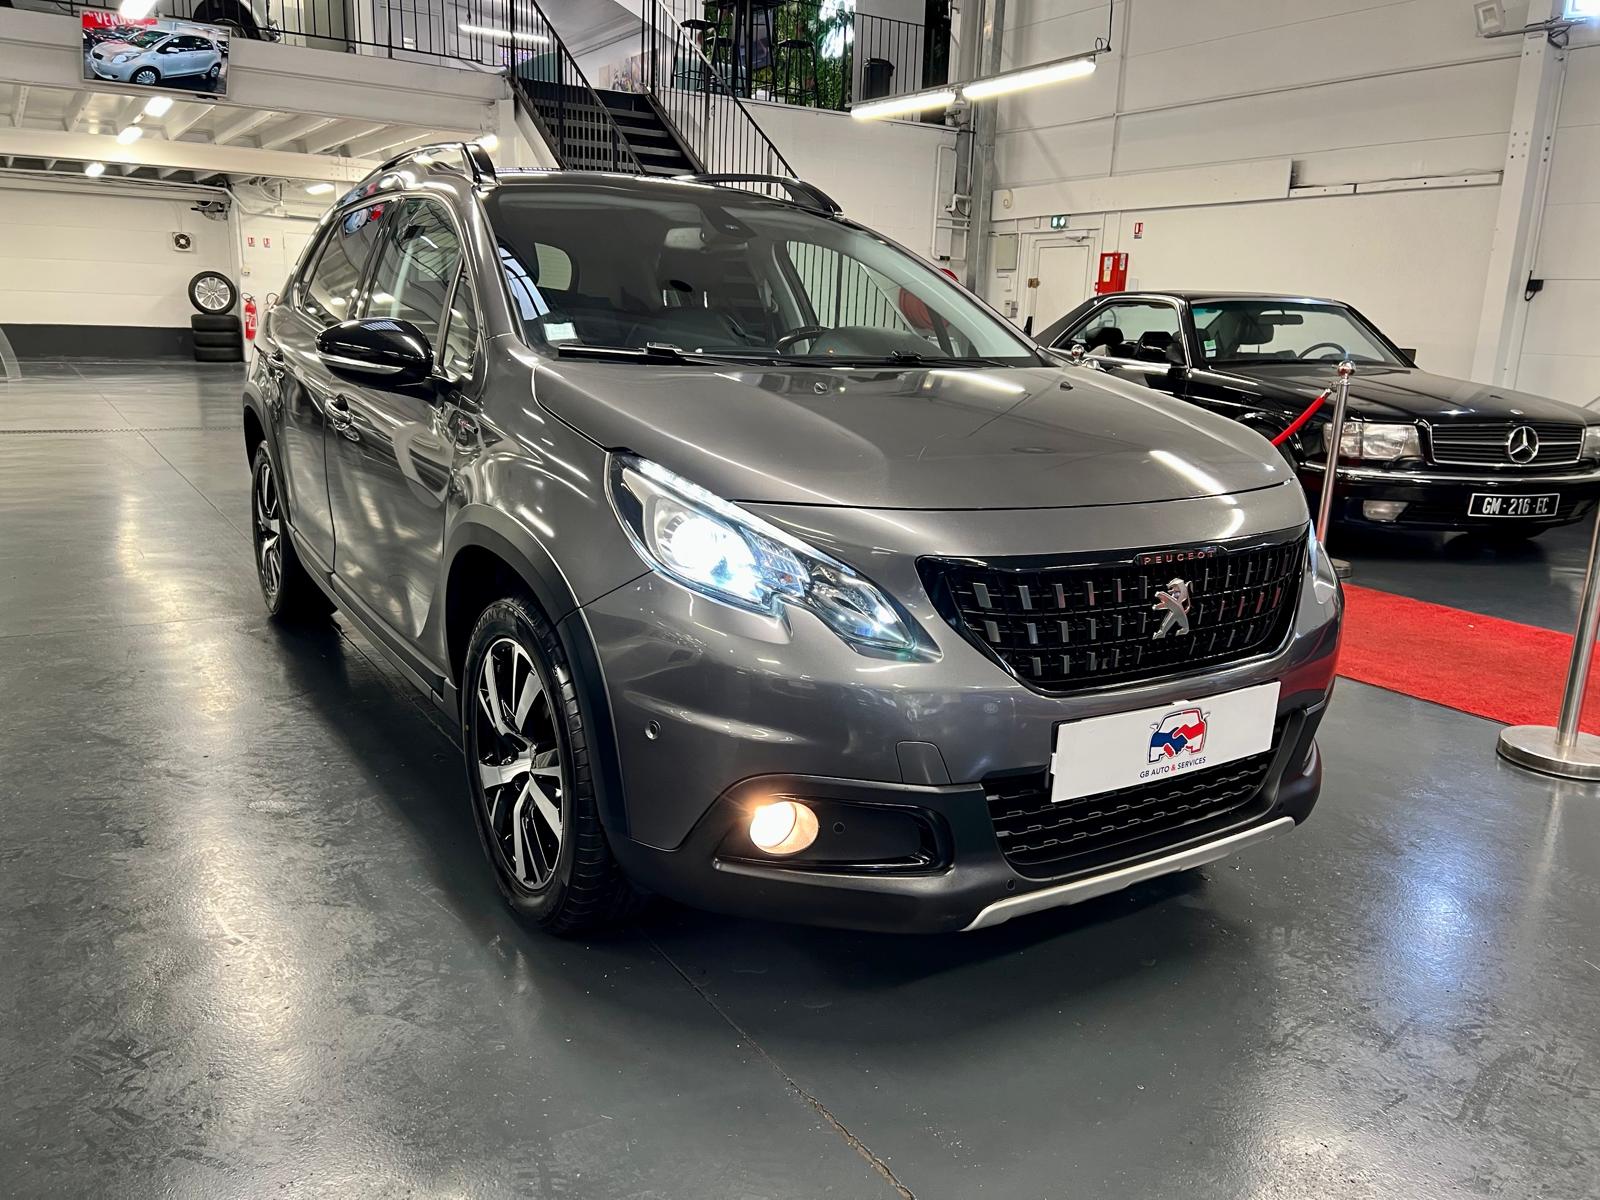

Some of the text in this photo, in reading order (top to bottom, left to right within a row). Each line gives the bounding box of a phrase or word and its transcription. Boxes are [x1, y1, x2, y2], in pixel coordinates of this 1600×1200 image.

[1143, 551, 1215, 565] PEUGEOT
[1139, 756, 1207, 779] GB AUTO & SERVICES
